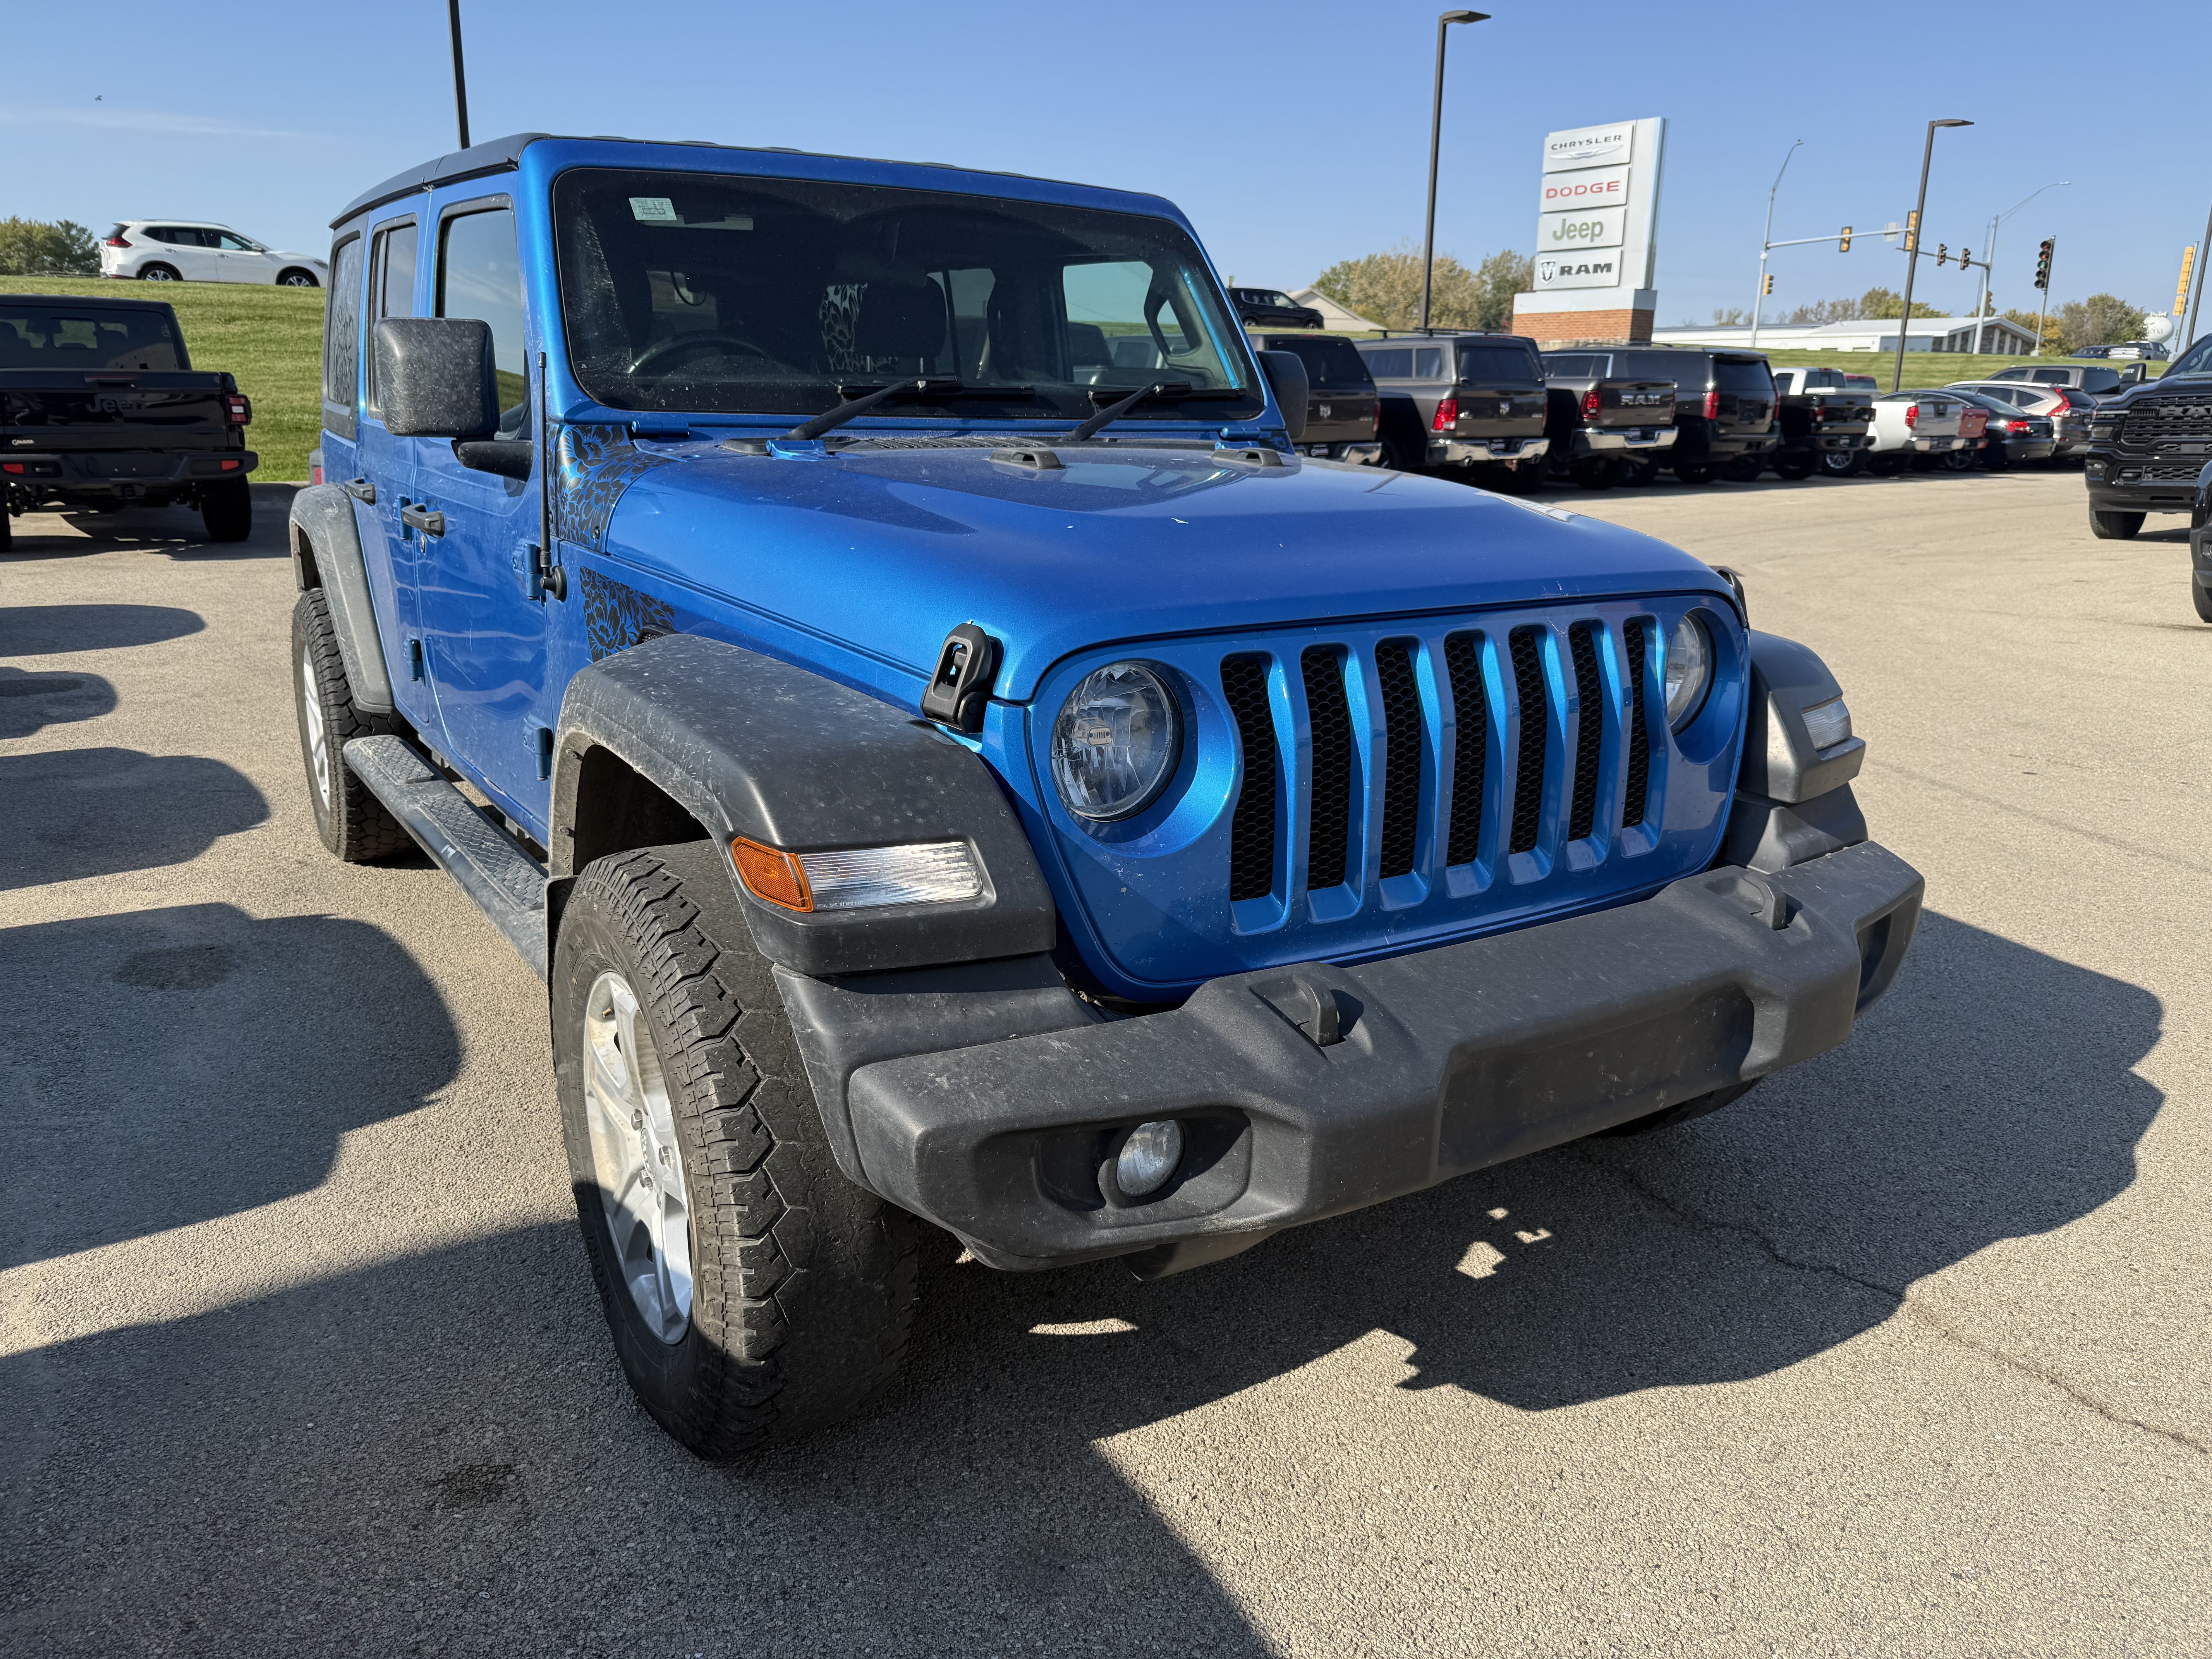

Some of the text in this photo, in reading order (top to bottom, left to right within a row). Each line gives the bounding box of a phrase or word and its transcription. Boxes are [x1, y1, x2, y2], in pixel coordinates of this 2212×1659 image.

[1551, 134, 1622, 150] CHRYSLER
[1546, 180, 1620, 199] DODGE
[1552, 218, 1604, 242] Jeep
[1559, 263, 1613, 276] RAM
[1620, 394, 1661, 405] RAM
[2160, 405, 2212, 417] RA
